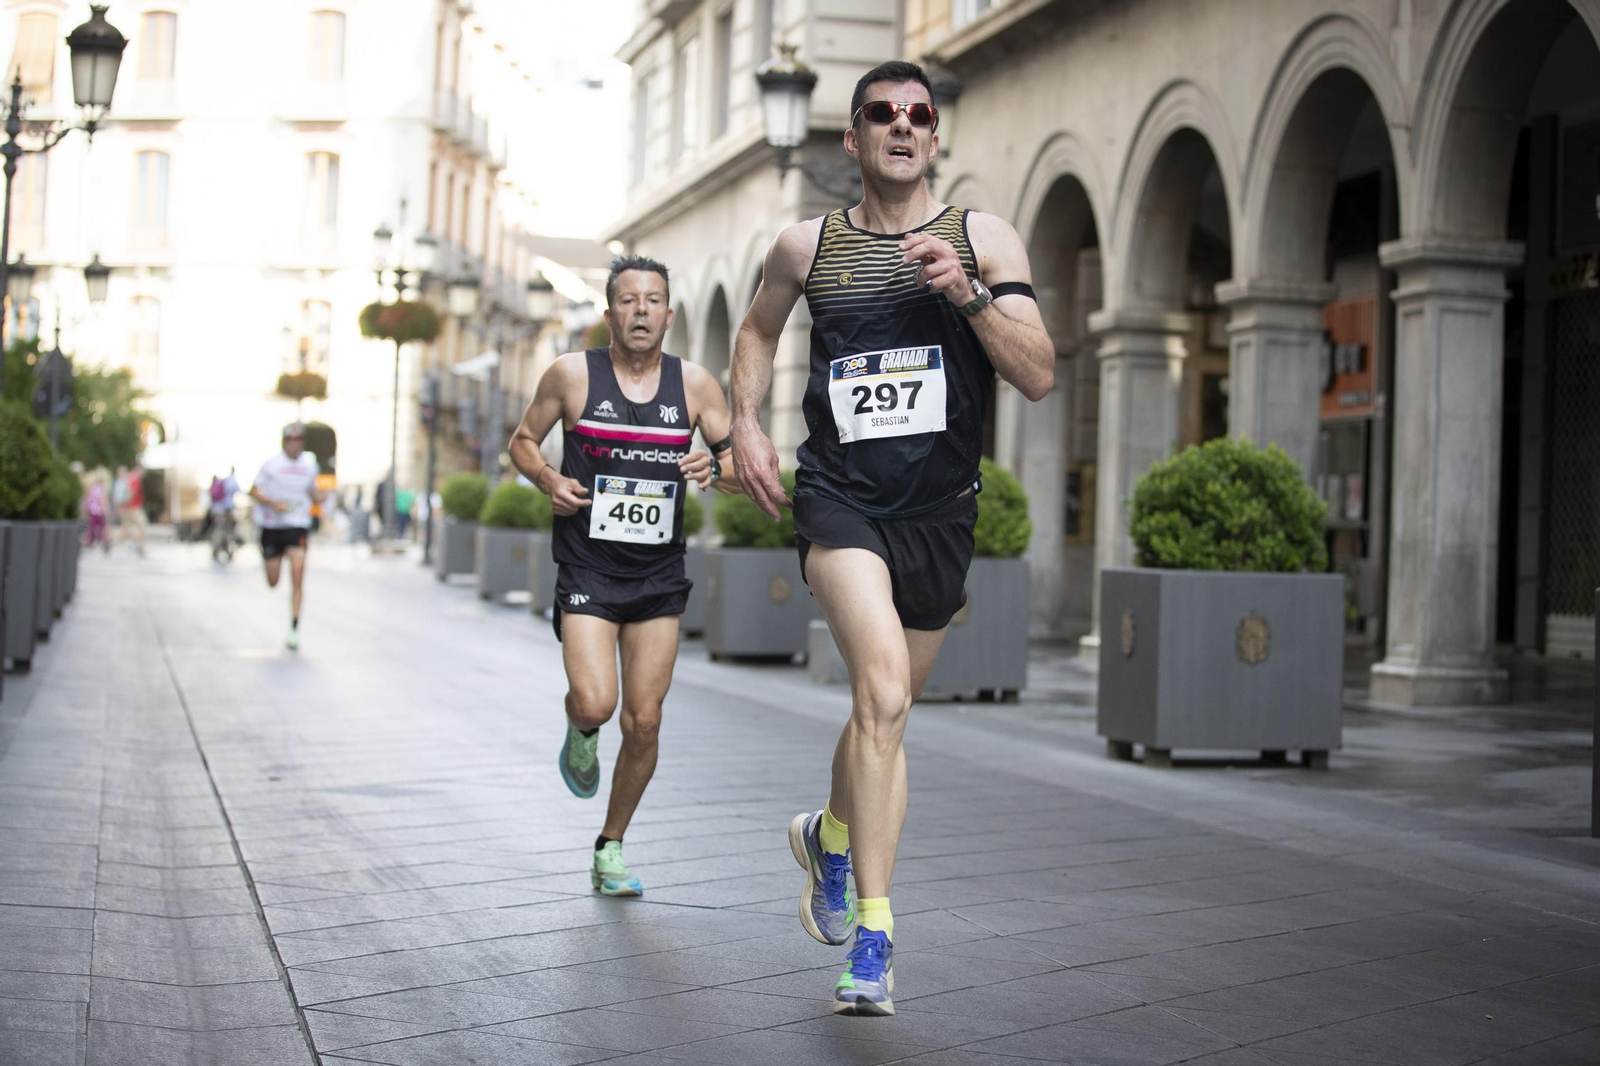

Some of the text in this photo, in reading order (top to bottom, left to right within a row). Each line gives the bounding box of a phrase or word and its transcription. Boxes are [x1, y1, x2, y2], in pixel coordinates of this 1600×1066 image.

[879, 349, 929, 370] GRANADA
[851, 380, 923, 415] 297
[871, 415, 910, 427] SEBASTIAN
[608, 501, 661, 525] 460
[624, 527, 646, 535] ANTONIO
